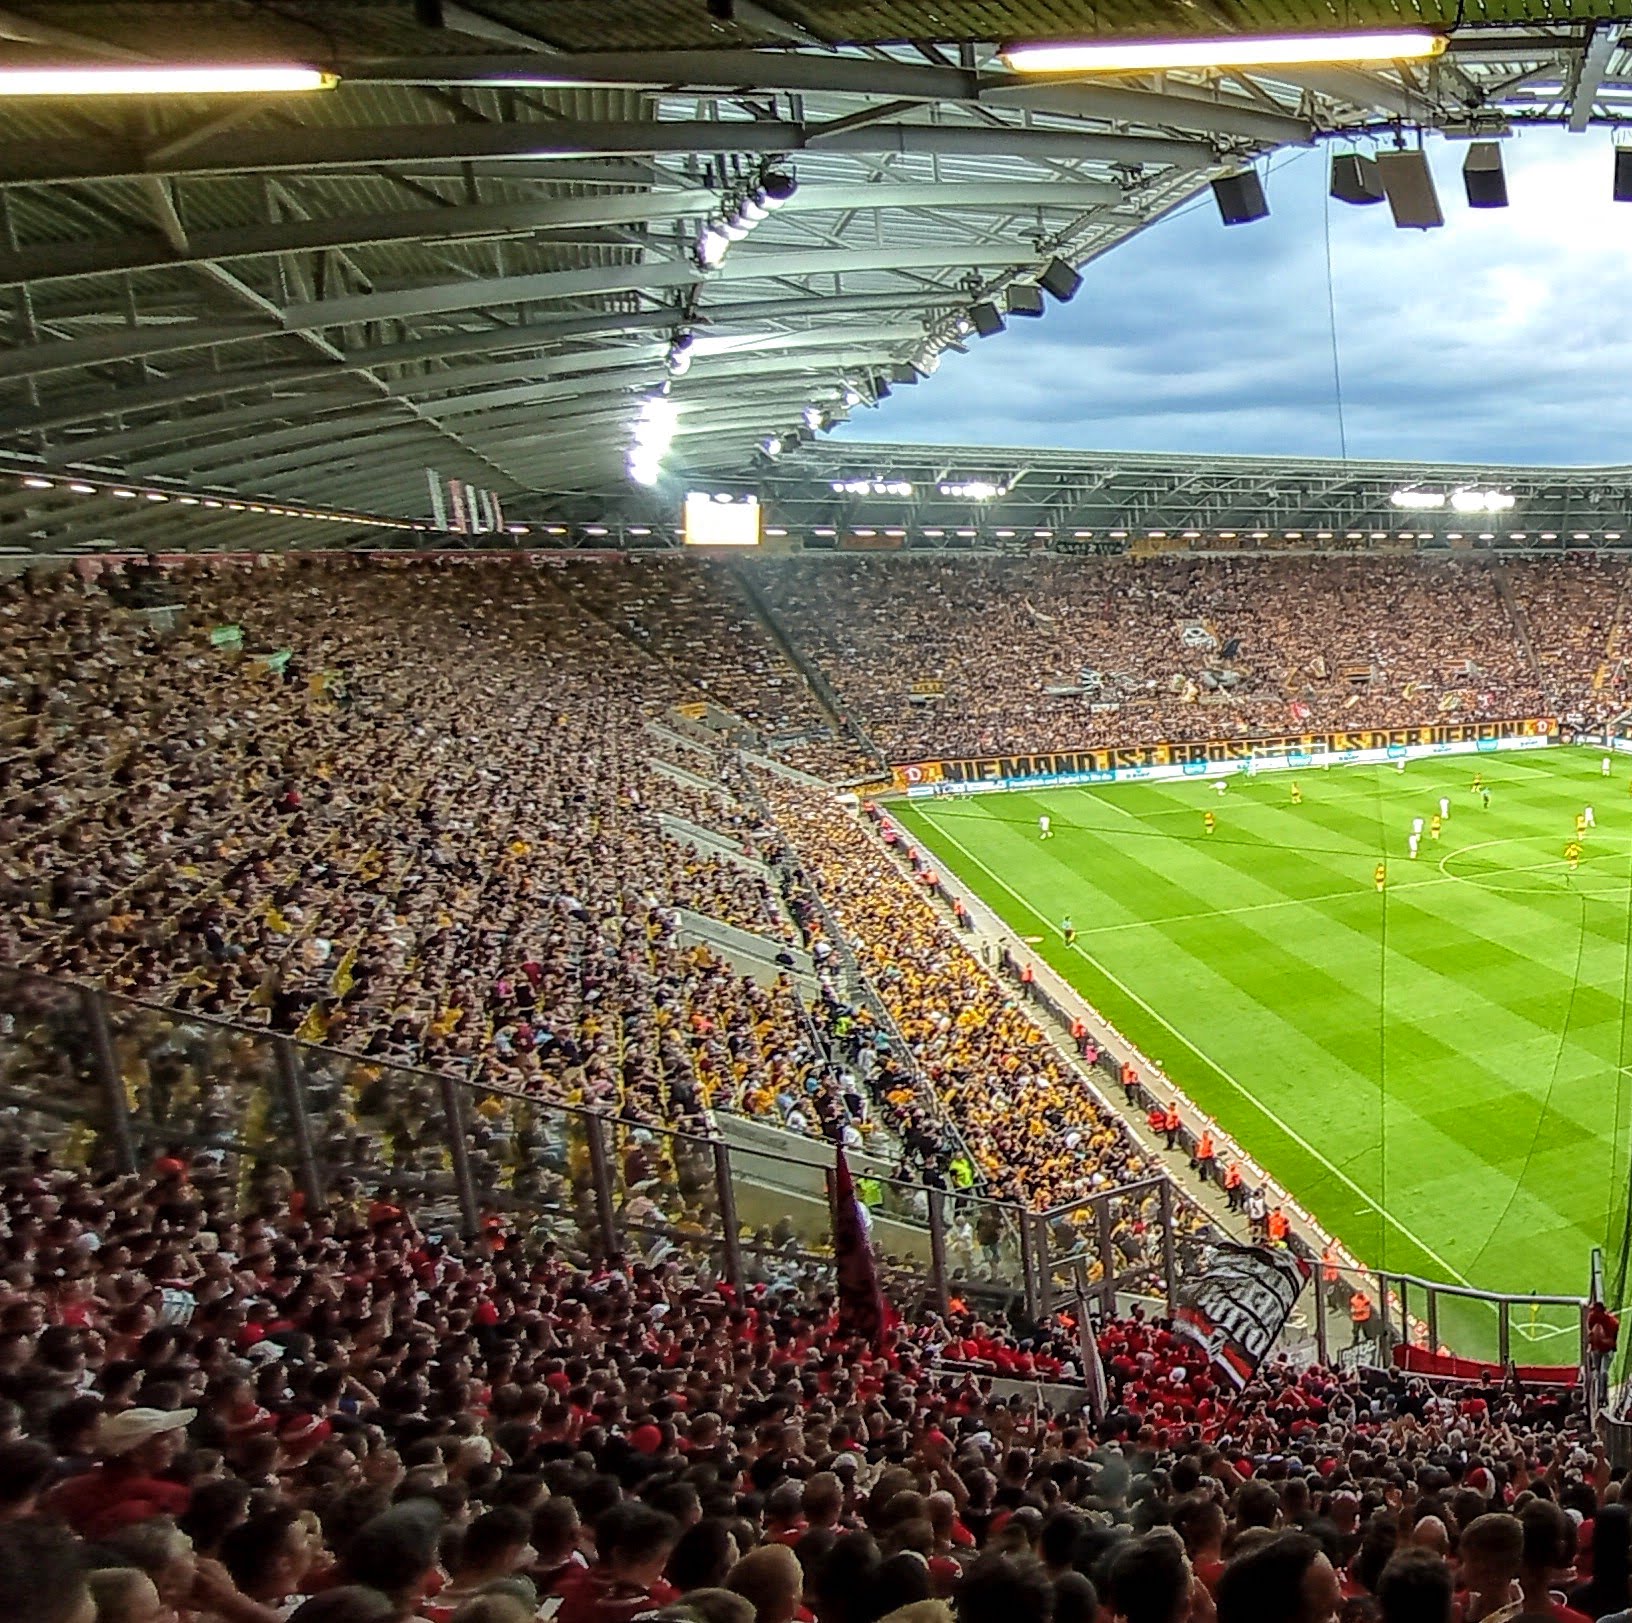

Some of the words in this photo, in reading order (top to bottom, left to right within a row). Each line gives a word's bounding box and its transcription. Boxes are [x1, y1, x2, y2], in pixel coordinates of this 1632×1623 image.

[942, 754, 1095, 783] NIEMAND
[1108, 747, 1160, 772] IST
[1310, 733, 1364, 755] ALS
[1371, 729, 1423, 749] DER
